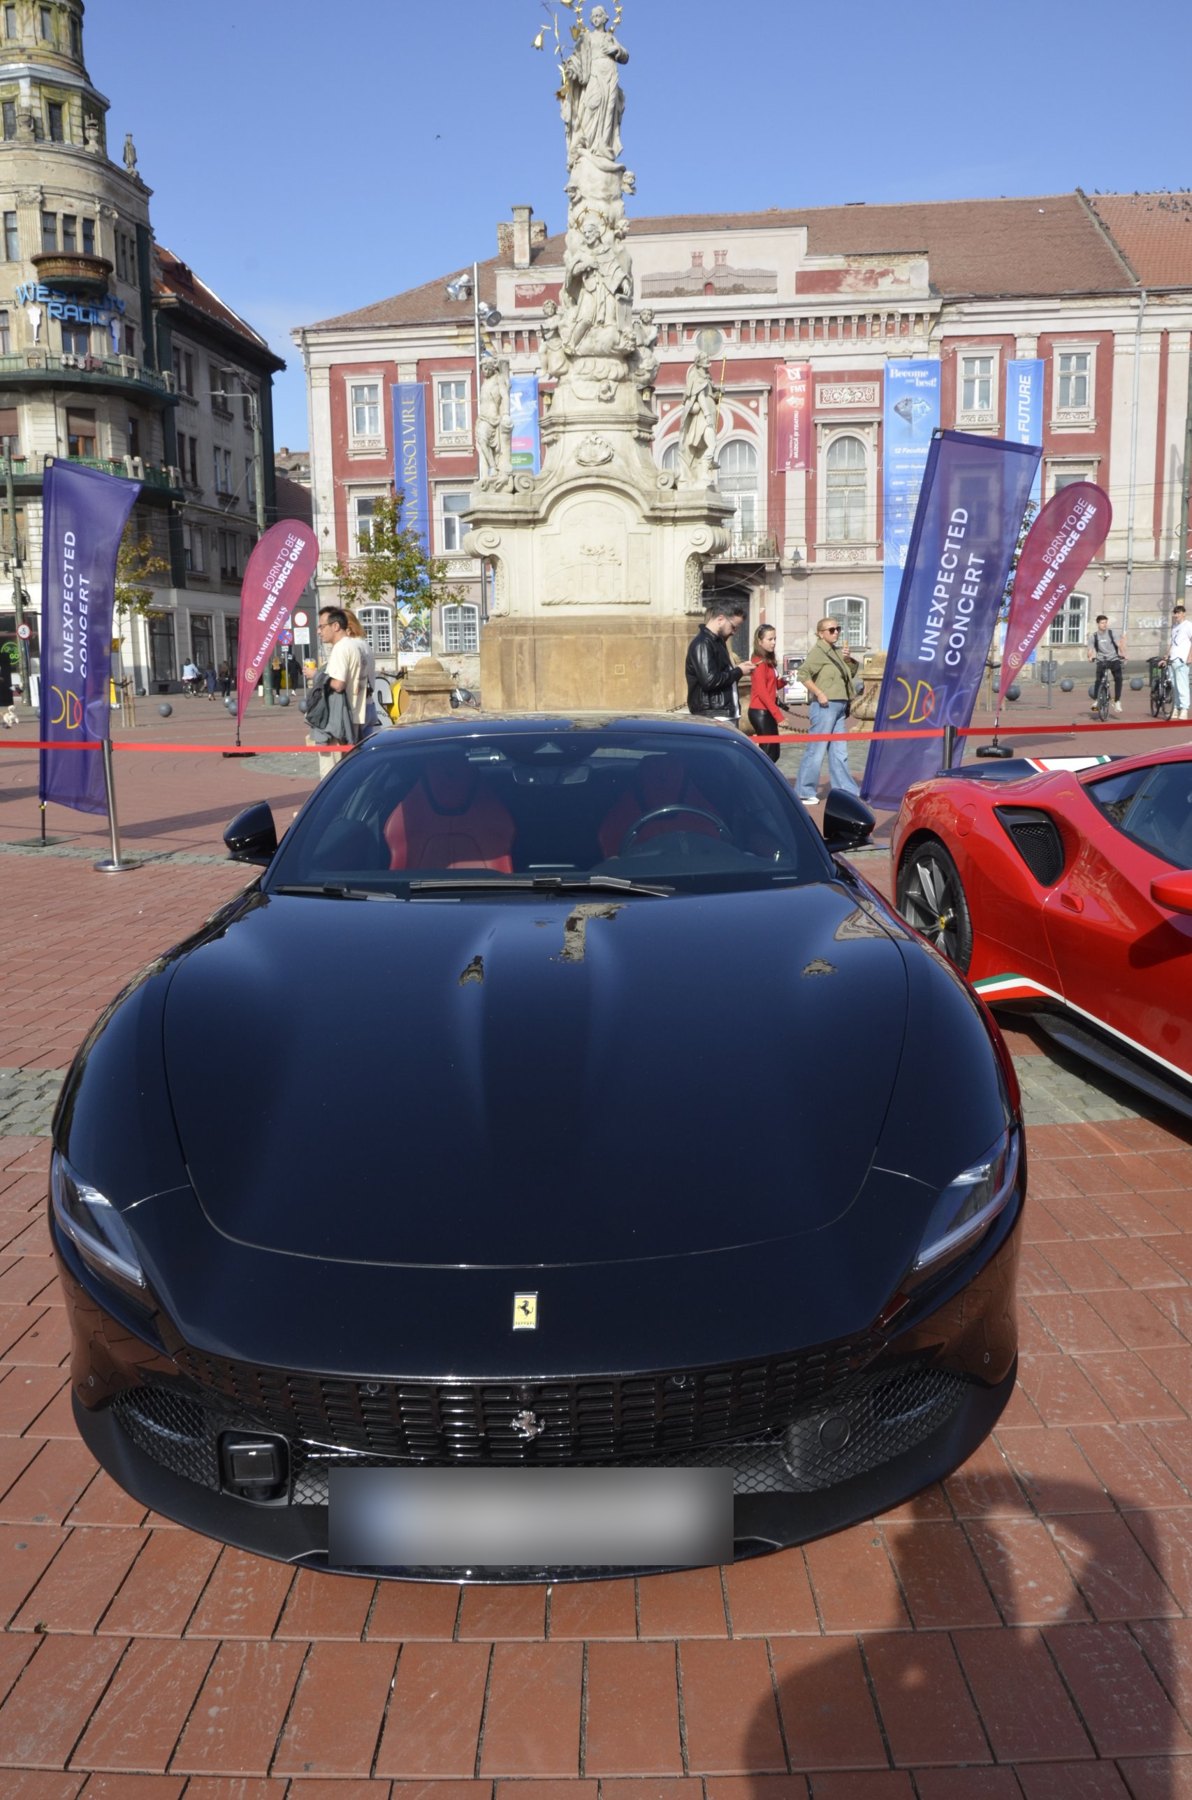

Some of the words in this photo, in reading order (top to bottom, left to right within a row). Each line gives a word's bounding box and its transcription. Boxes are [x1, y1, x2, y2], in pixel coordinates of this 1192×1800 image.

[47, 302, 111, 326] RADIO
[890, 368, 928, 378] Become
[1018, 374, 1031, 432] FUTURE
[402, 393, 419, 484] ABSOLVIRE
[262, 562, 283, 591] BORN
[277, 547, 290, 562] TO
[284, 532, 298, 547] BE
[1031, 567, 1056, 601] WINE
[1051, 529, 1080, 571] FORCE
[1076, 503, 1097, 531] ONE
[1042, 530, 1067, 564] BORN
[1062, 514, 1077, 531] TO
[1073, 497, 1088, 514] BE
[63, 531, 76, 673] UNEXPECTED
[257, 594, 277, 623] WINE
[271, 560, 294, 596] FORCE
[289, 538, 306, 562] ONE
[918, 508, 968, 662] UNEXPECTED
[945, 553, 985, 666] CONCERT
[79, 573, 91, 678] CONCERT
[1018, 610, 1048, 652] CRAMELE
